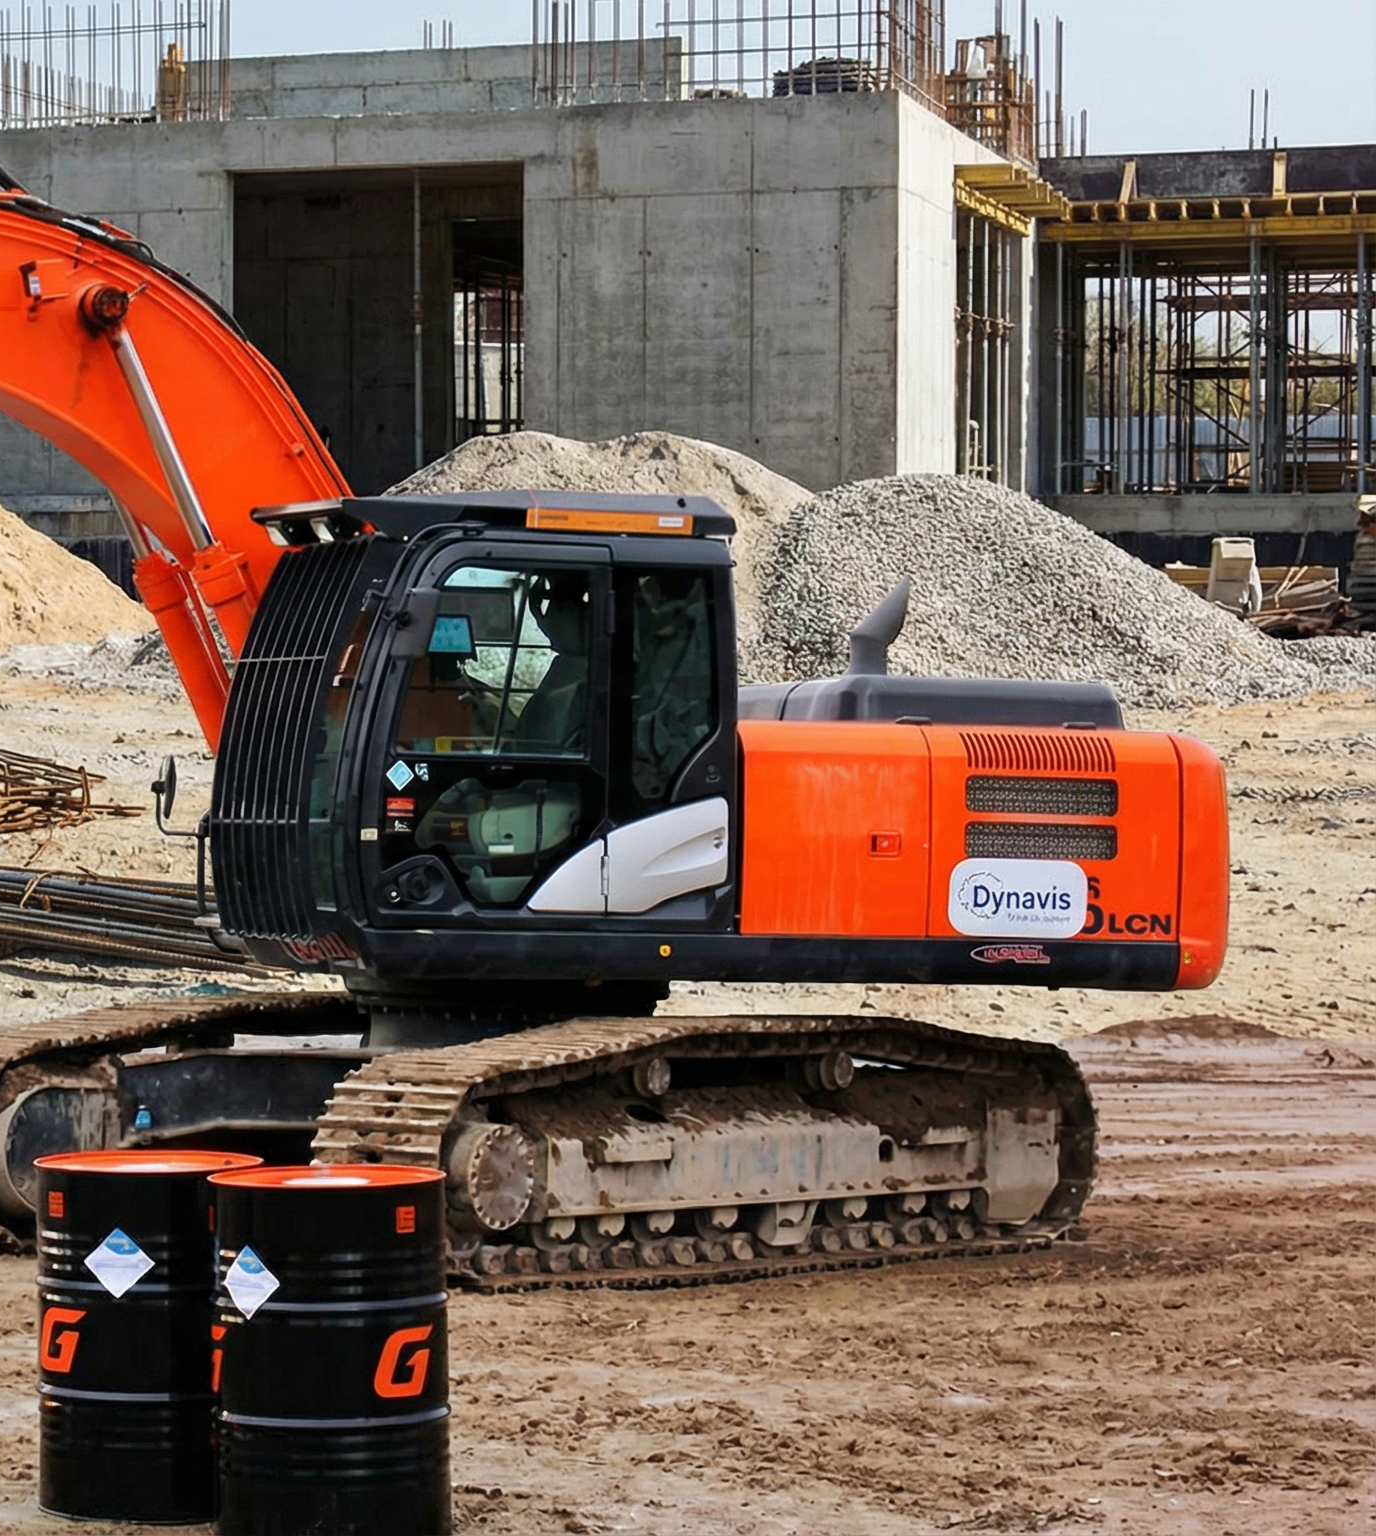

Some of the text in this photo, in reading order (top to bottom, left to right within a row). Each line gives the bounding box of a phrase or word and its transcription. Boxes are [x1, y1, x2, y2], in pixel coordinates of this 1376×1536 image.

[974, 885, 1071, 915] Dynavis
[40, 1307, 87, 1373] G
[374, 1324, 432, 1398] G
